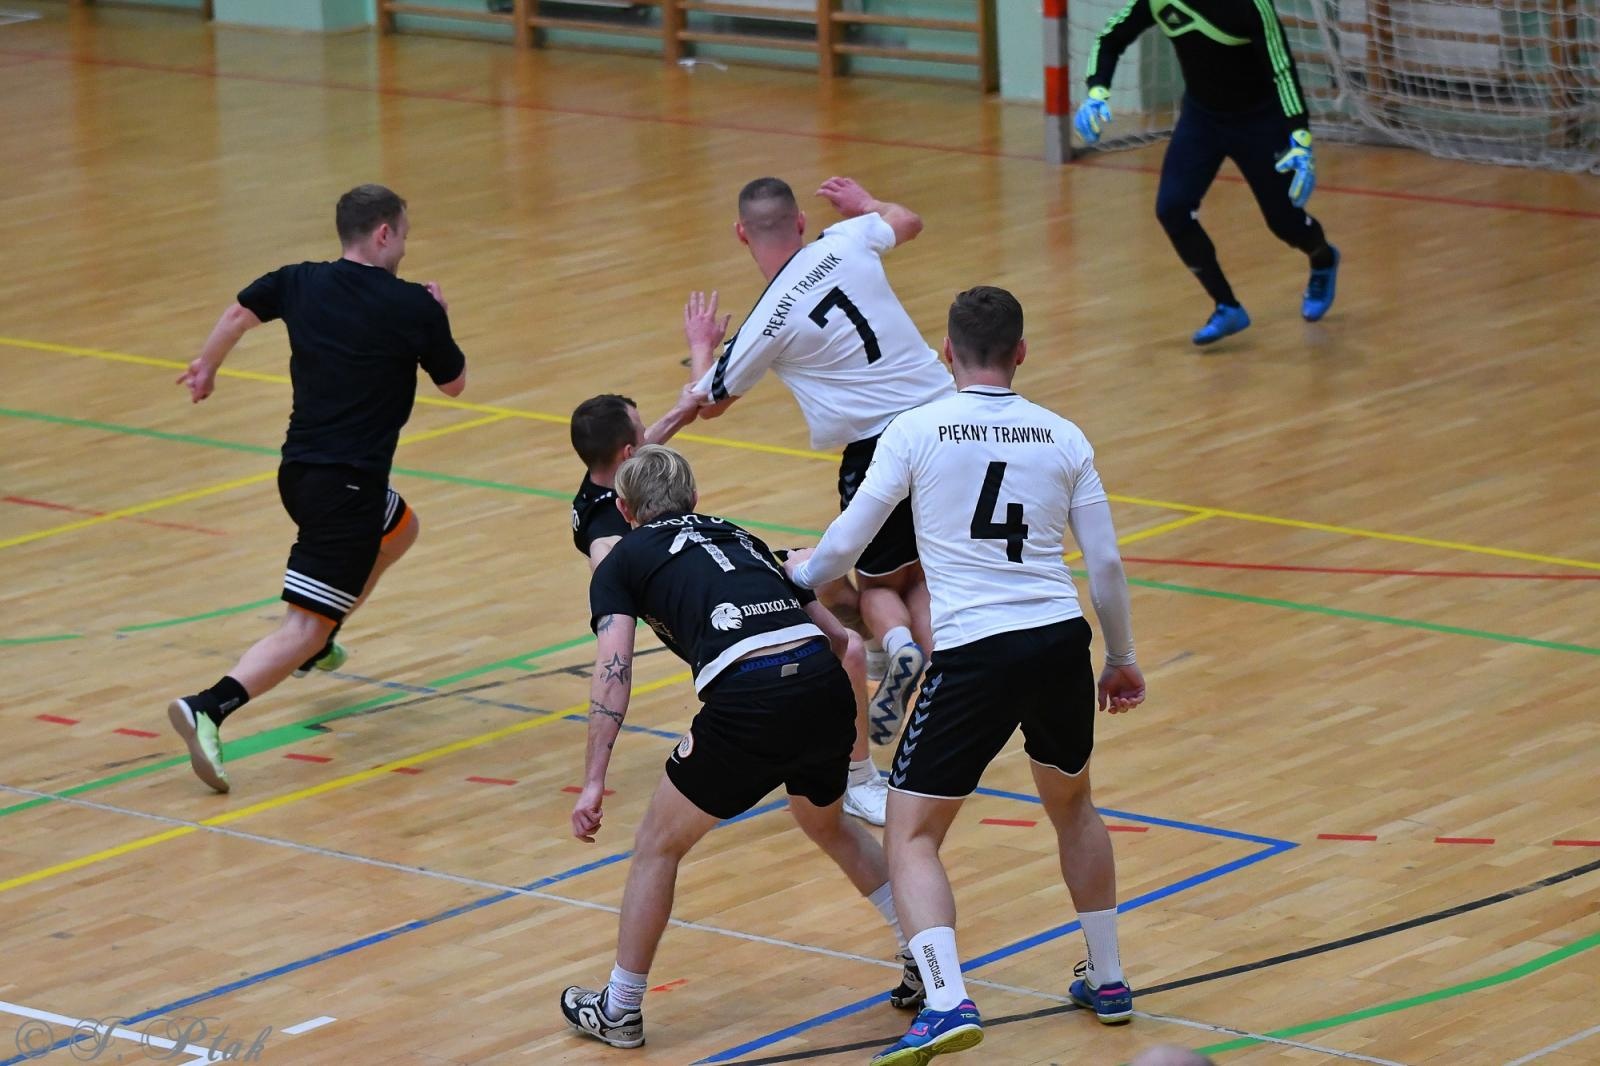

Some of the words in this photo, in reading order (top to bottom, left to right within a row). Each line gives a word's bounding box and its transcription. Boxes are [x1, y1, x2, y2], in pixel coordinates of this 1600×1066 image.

[763, 293, 797, 338] PIĘKNY
[792, 253, 842, 295] TRAWNIK
[808, 286, 882, 365] 7
[938, 424, 988, 444] PIĘKNY
[992, 426, 1055, 444] TRAWNIK
[970, 461, 1029, 564] 4
